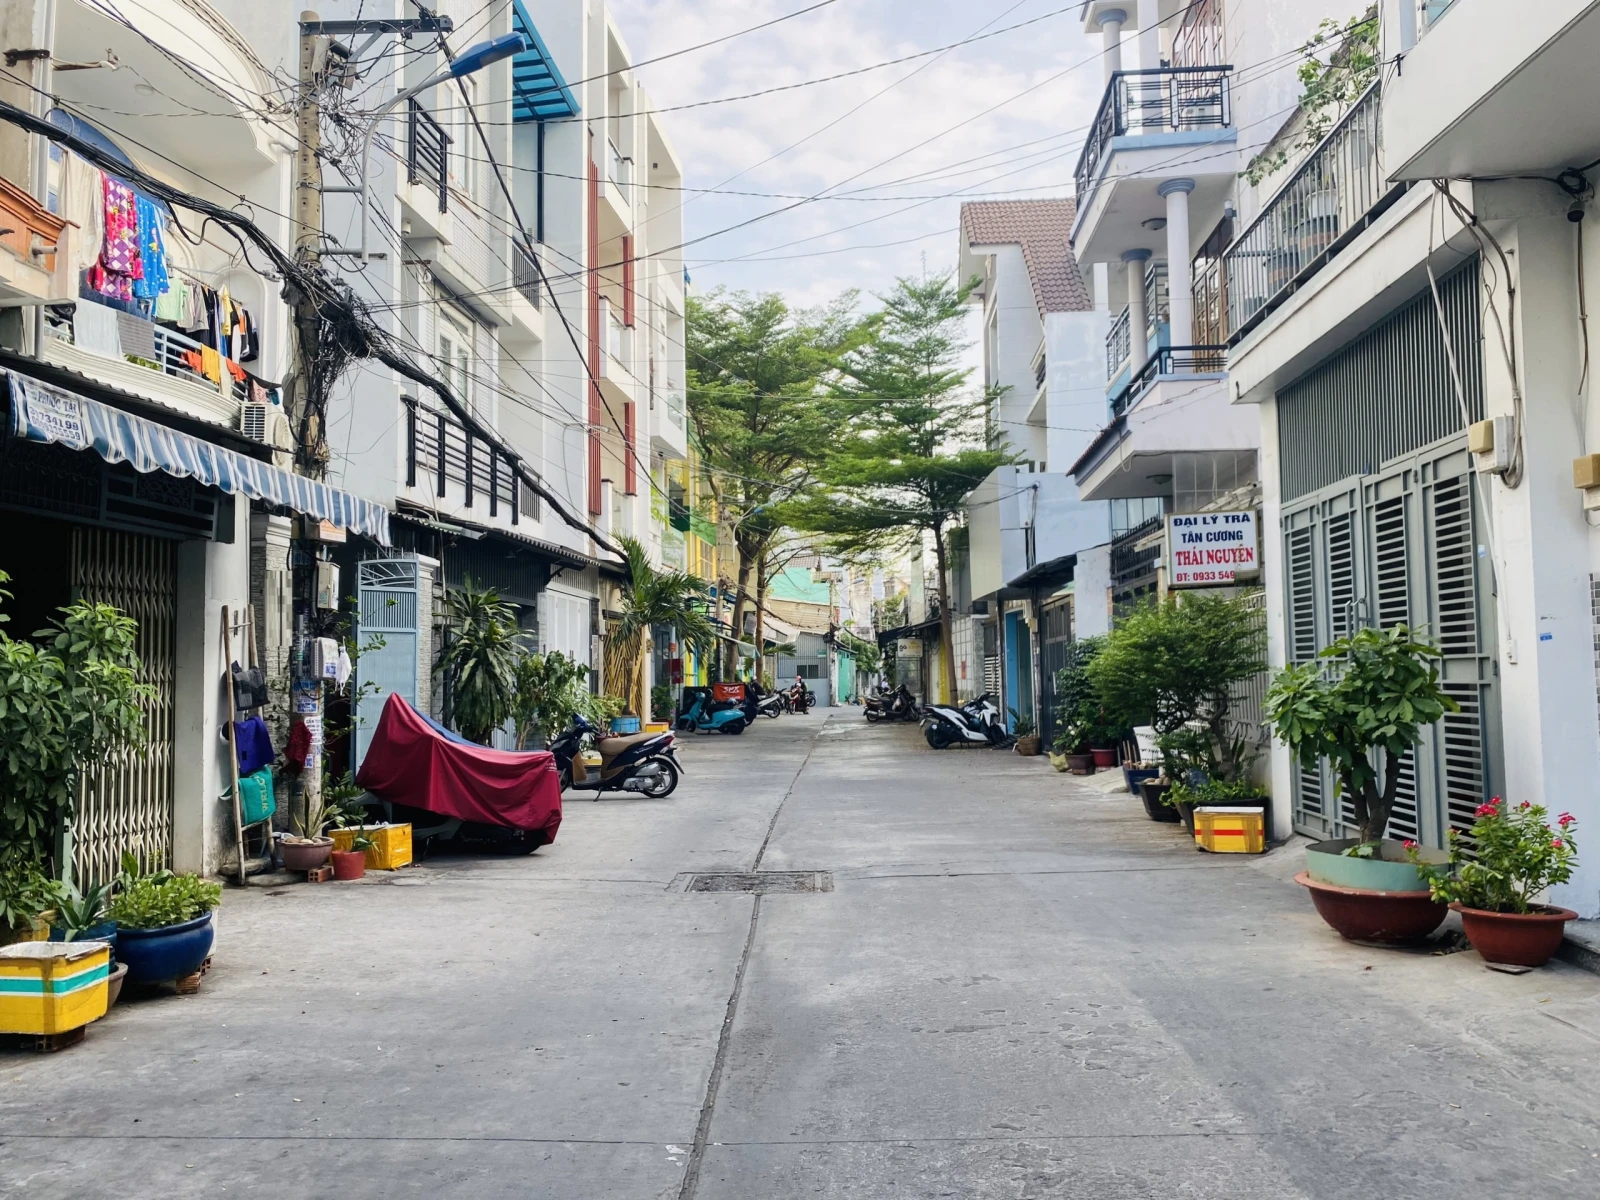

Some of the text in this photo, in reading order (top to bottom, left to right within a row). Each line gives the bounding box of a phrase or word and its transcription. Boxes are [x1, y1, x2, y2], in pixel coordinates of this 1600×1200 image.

[1173, 512, 1251, 528] ĐẠI LÝ TRÀ
[1181, 530, 1244, 544] TÂN CƯƠNG
[1175, 546, 1204, 566] THÁI
[1192, 571, 1216, 581] 0933
